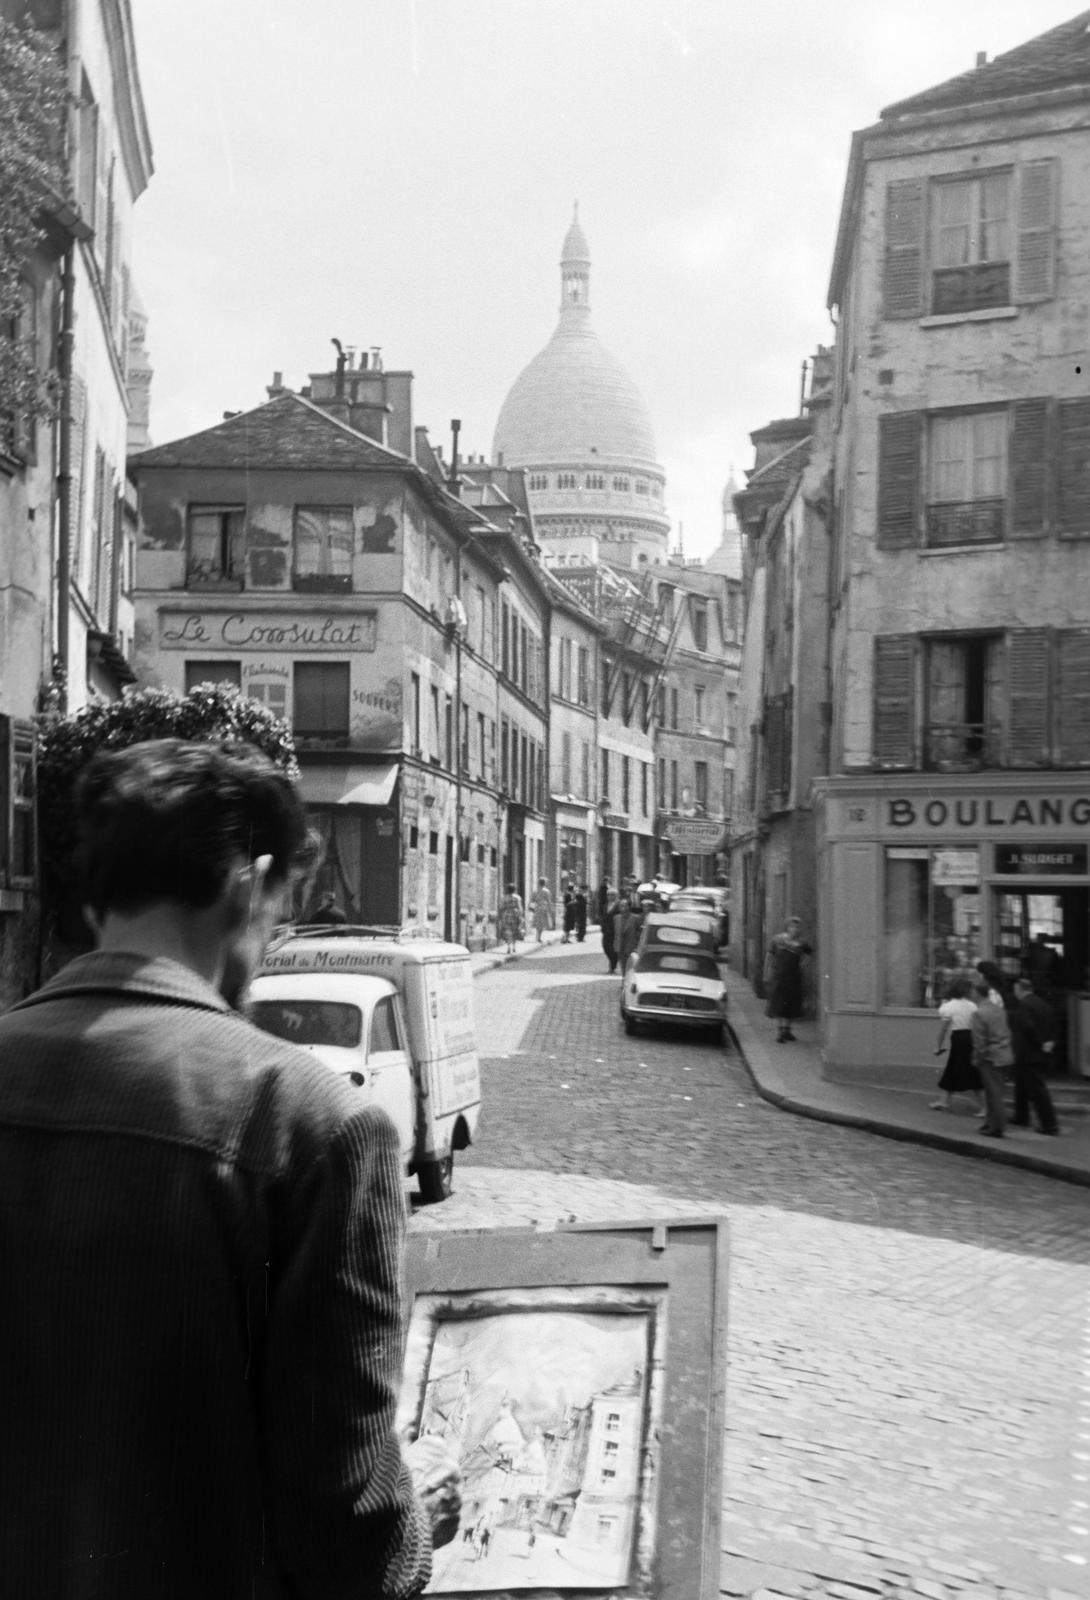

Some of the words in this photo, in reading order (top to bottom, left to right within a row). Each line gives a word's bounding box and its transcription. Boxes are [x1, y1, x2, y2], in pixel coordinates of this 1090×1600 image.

[163, 615, 211, 642] Le
[221, 613, 361, 645] Consulat
[887, 799, 1090, 827] BOULANG
[313, 951, 395, 967] Montmartre
